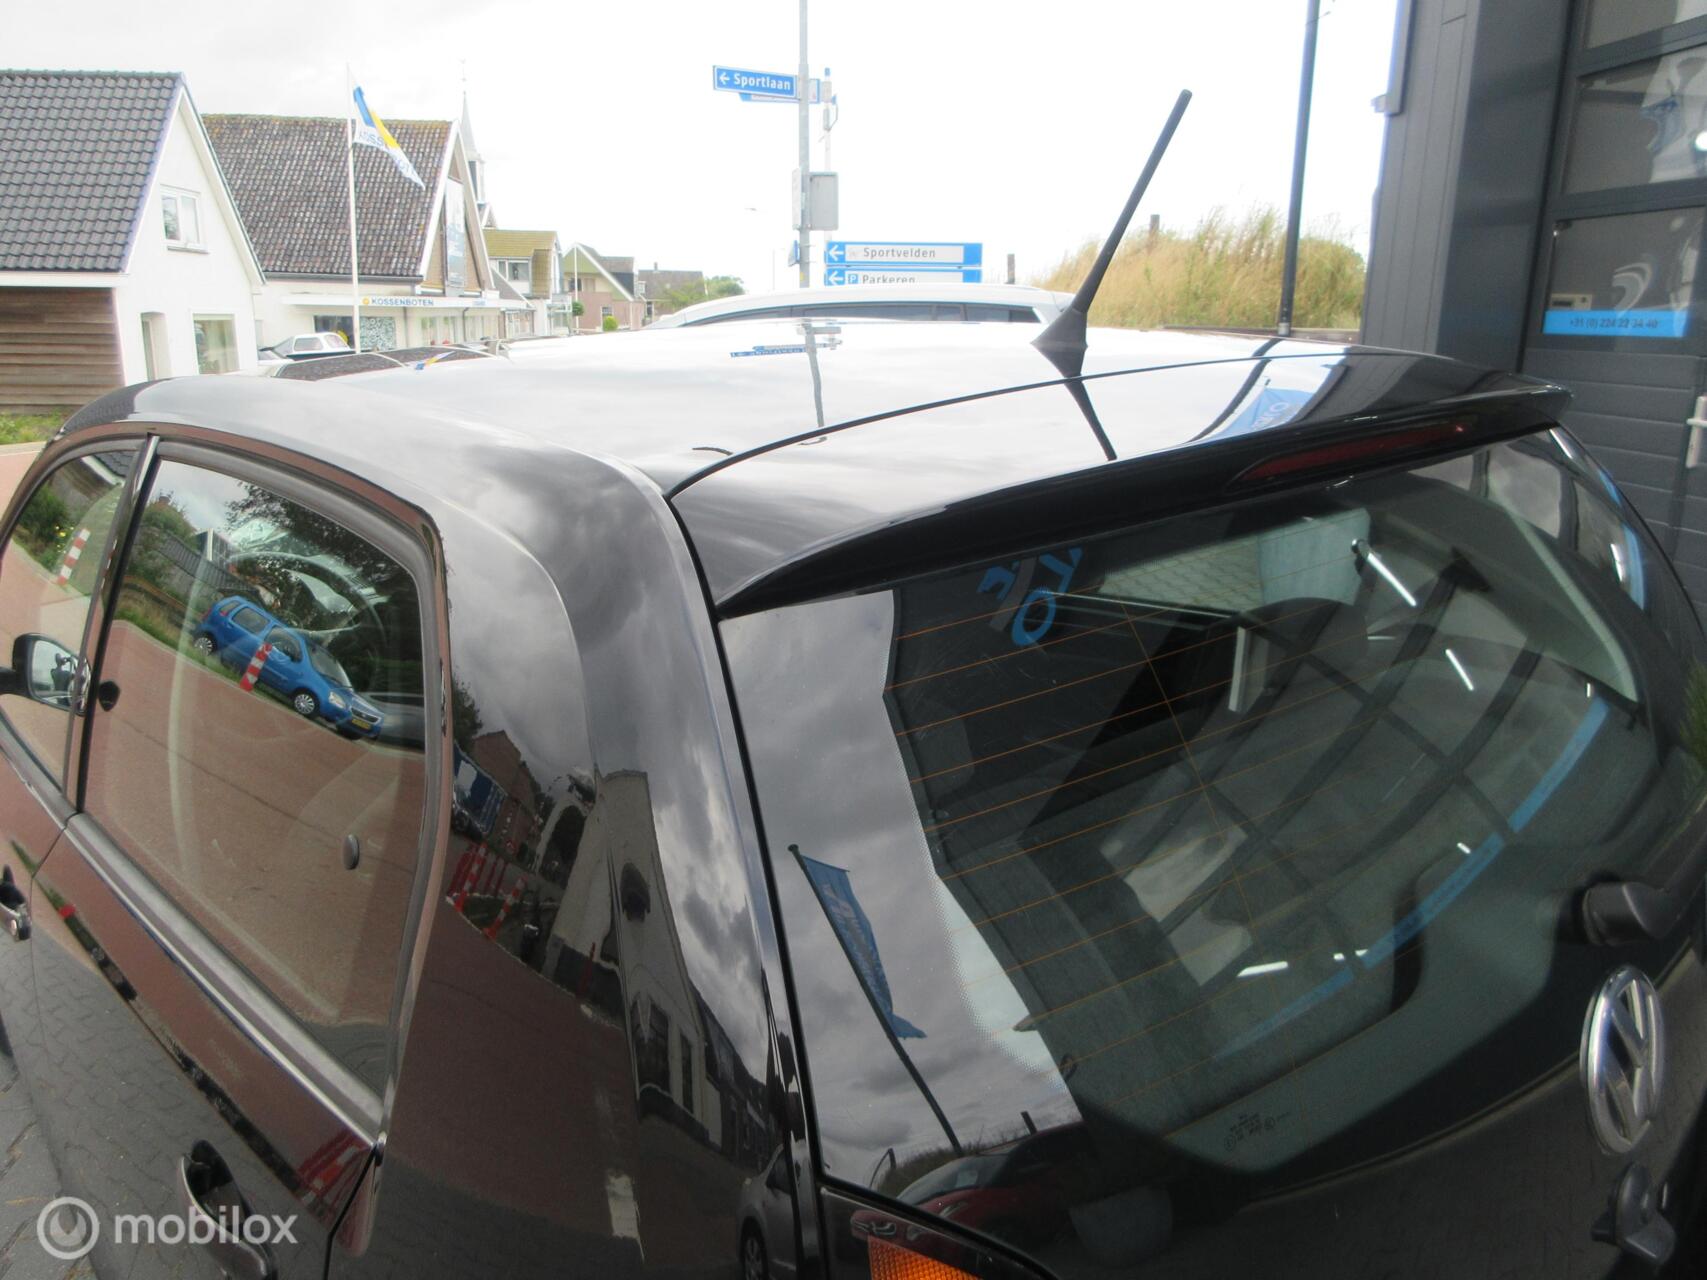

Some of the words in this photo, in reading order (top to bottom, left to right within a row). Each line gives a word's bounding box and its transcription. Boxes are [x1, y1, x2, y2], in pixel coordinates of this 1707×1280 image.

[733, 73, 791, 91] Sportlaan
[863, 247, 936, 259] Sportvelden
[862, 274, 916, 284] Parkeren
[371, 298, 434, 306] KOSSENBOTEN
